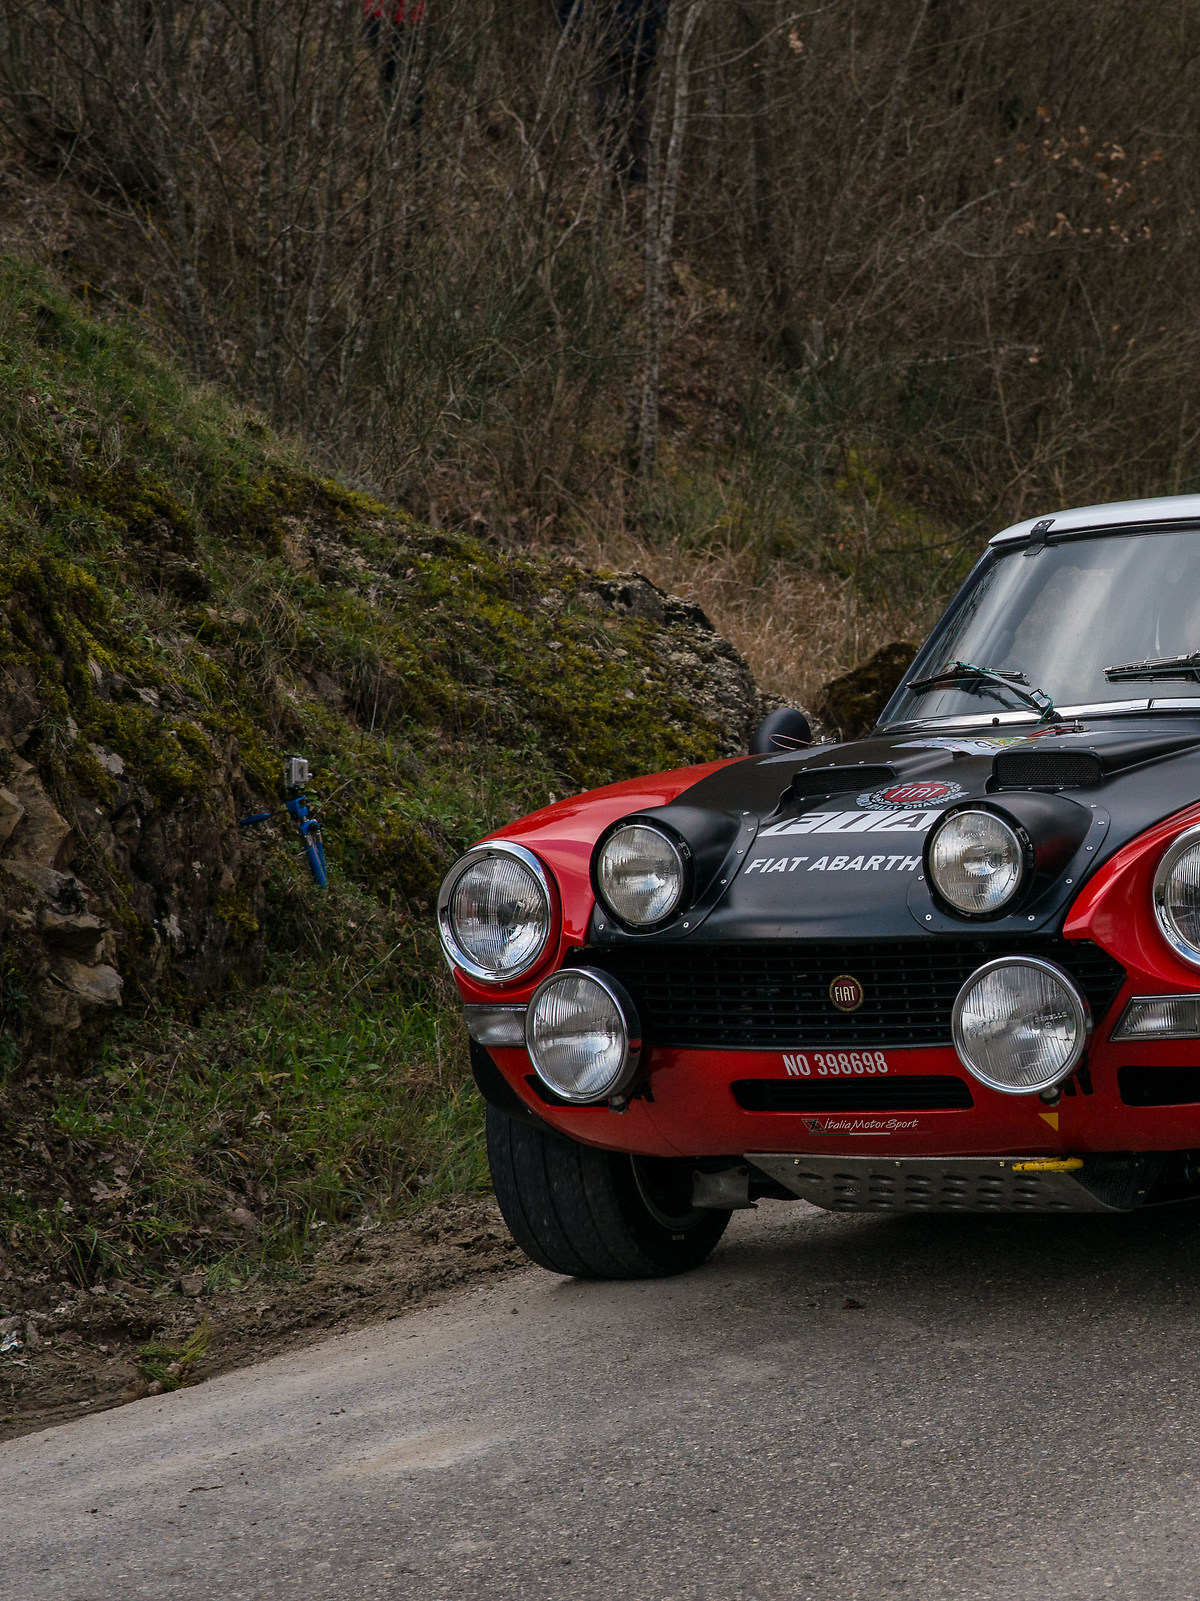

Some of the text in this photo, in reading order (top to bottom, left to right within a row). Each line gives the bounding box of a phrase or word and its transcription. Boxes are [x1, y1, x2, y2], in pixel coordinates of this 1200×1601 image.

[890, 787, 945, 799] FIAT
[766, 811, 936, 834] FIA
[744, 855, 923, 875] FIAT ABARTH
[834, 985, 855, 1002] FIAT
[782, 1051, 889, 1076] NO 398698
